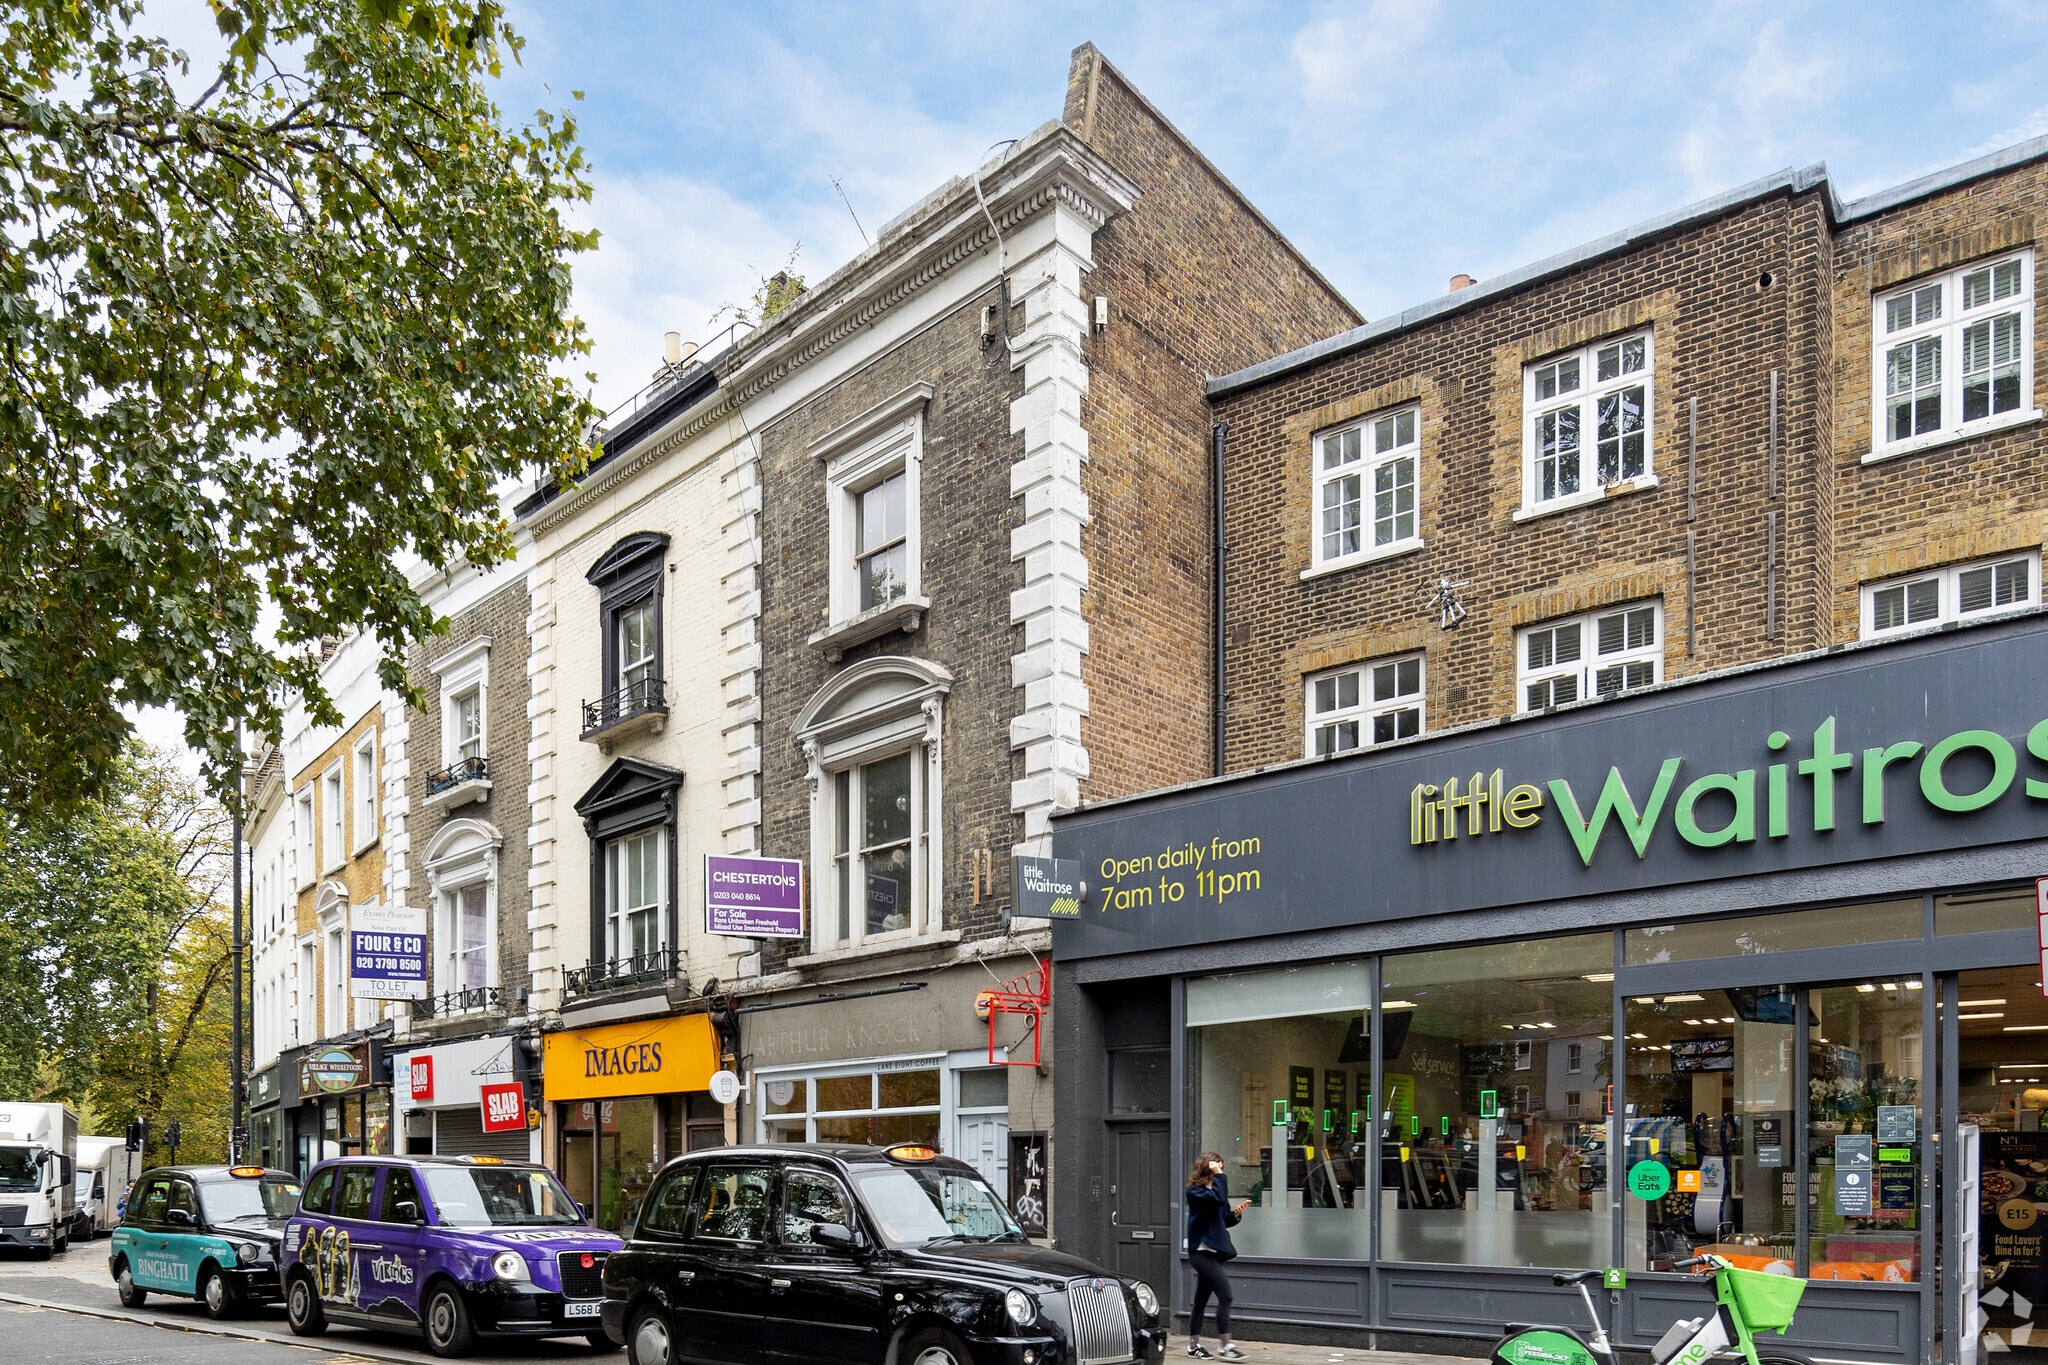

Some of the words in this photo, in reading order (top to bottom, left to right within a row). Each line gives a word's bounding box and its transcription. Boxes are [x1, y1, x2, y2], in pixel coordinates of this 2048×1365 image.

[1410, 767, 1544, 846] little
[1101, 856, 1152, 883] Open
[1157, 841, 1206, 871] daily
[1211, 837, 1260, 861] from
[1024, 865, 1043, 878] little
[713, 871, 796, 887] CHESTERTONS
[1025, 878, 1072, 894] Waitrose
[1101, 886, 1152, 913] 7am
[1159, 875, 1185, 903] to
[1196, 869, 1260, 905] 11pm
[714, 891, 730, 899] 0203
[745, 893, 760, 901] 8614
[714, 909, 728, 917] For
[729, 910, 746, 918] Sale
[776, 926, 798, 934] Property
[356, 934, 392, 952] FOUR
[393, 936, 402, 952] &
[404, 937, 421, 953] CO
[356, 956, 373, 969] 020
[375, 957, 398, 970] 3790
[400, 959, 421, 971] 8500
[370, 980, 386, 991] TO
[388, 981, 408, 991] LET
[372, 990, 395, 998] FLOOR
[585, 1042, 662, 1077] IMAGES
[878, 1062, 893, 1070] LANE
[895, 1060, 913, 1069] EIGHT
[915, 1058, 940, 1067] COFFEE
[1411, 1052, 1428, 1072] Self
[1428, 1058, 1455, 1075] service
[308, 1063, 328, 1071] VILLAGE
[412, 1064, 428, 1086] SLAB
[413, 1085, 427, 1093] CITY
[488, 1092, 519, 1116] SLAB
[490, 1113, 519, 1122] CITY
[1638, 1174, 1660, 1182] Uber
[1638, 1182, 1660, 1191] Eats
[2006, 1208, 2029, 1220] £15
[1995, 1235, 2013, 1245] Food
[1995, 1245, 2012, 1256] Dine
[2014, 1246, 2021, 1256] In
[2022, 1246, 2034, 1256] for
[2036, 1246, 2041, 1256] 2
[138, 1259, 189, 1281] BINGHATTI
[569, 1304, 593, 1315] LS68
